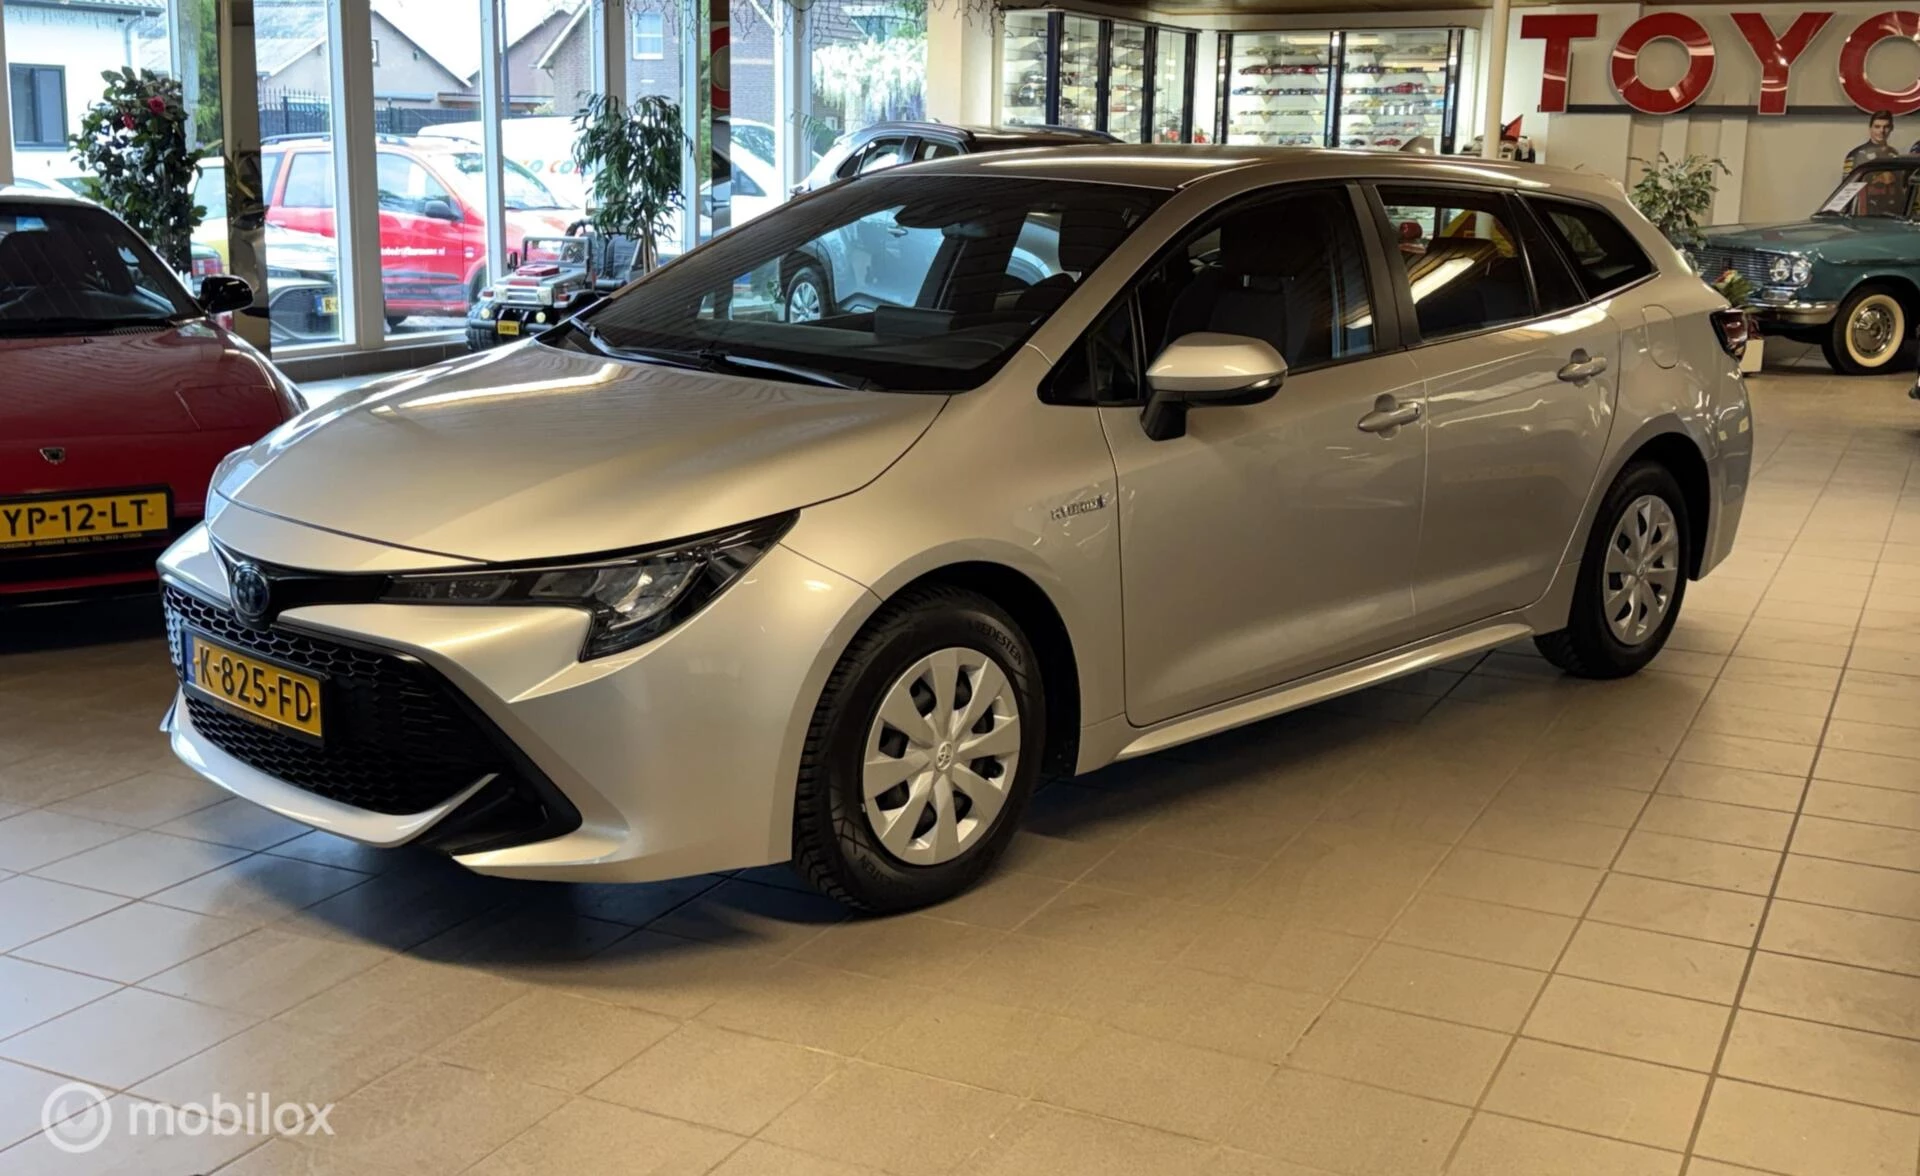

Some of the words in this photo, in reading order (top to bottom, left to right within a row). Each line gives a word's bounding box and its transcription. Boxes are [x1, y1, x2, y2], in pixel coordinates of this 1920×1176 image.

[1520, 11, 1920, 117] TOYO
[3, 499, 149, 537] YP-12-LT
[199, 644, 313, 723] K-825-FD
